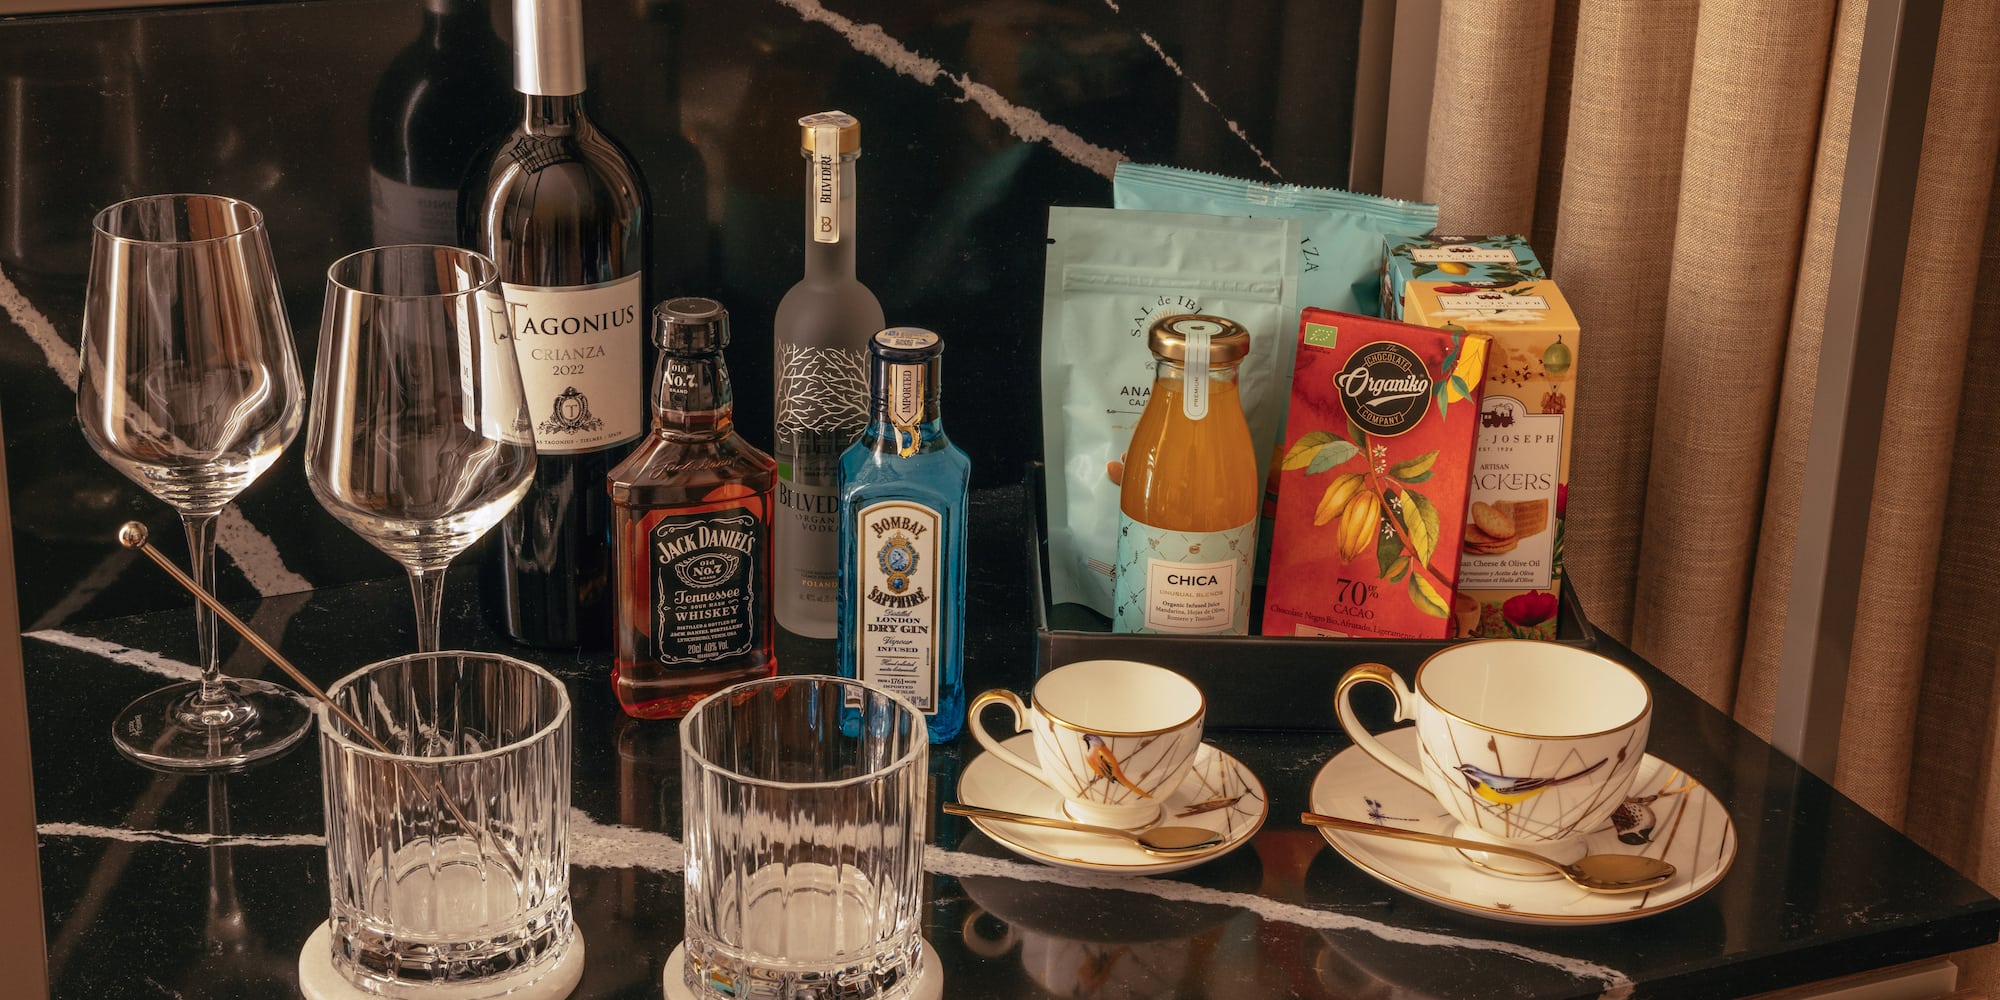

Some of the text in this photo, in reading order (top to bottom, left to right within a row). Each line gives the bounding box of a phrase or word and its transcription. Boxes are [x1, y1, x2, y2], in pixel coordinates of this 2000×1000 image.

[820, 154, 832, 204] BELVEDERE
[506, 302, 635, 341] TAGONIUS
[1131, 305, 1154, 338] SAL
[1157, 296, 1171, 306] de
[531, 345, 606, 361] CRIANZA
[671, 364, 687, 373] Old
[1366, 352, 1410, 371] CHOCOLATE
[552, 364, 585, 376] 2022
[1338, 367, 1429, 398] Organiko
[902, 370, 912, 413] IMPORTED
[1362, 410, 1401, 426] COMPANY
[1479, 463, 1510, 471] ARTISAN
[801, 522, 838, 533] VODK
[871, 516, 928, 540] BOMBAY
[657, 532, 697, 564] JACK
[1167, 574, 1218, 586] CHICA
[673, 588, 740, 604] Tennessee
[867, 585, 930, 609] SAPPHIRE
[1159, 589, 1194, 598] UNUSUAL
[1162, 600, 1185, 608] Organic
[1333, 604, 1375, 620] CACAO
[675, 605, 740, 622] WHISKEY
[883, 608, 912, 617] Distilled
[1270, 603, 1304, 618] Chocolate
[1304, 611, 1326, 623] Negro
[867, 624, 929, 634] DRY GIN
[687, 643, 702, 655] 20cl
[703, 641, 718, 652] 40%
